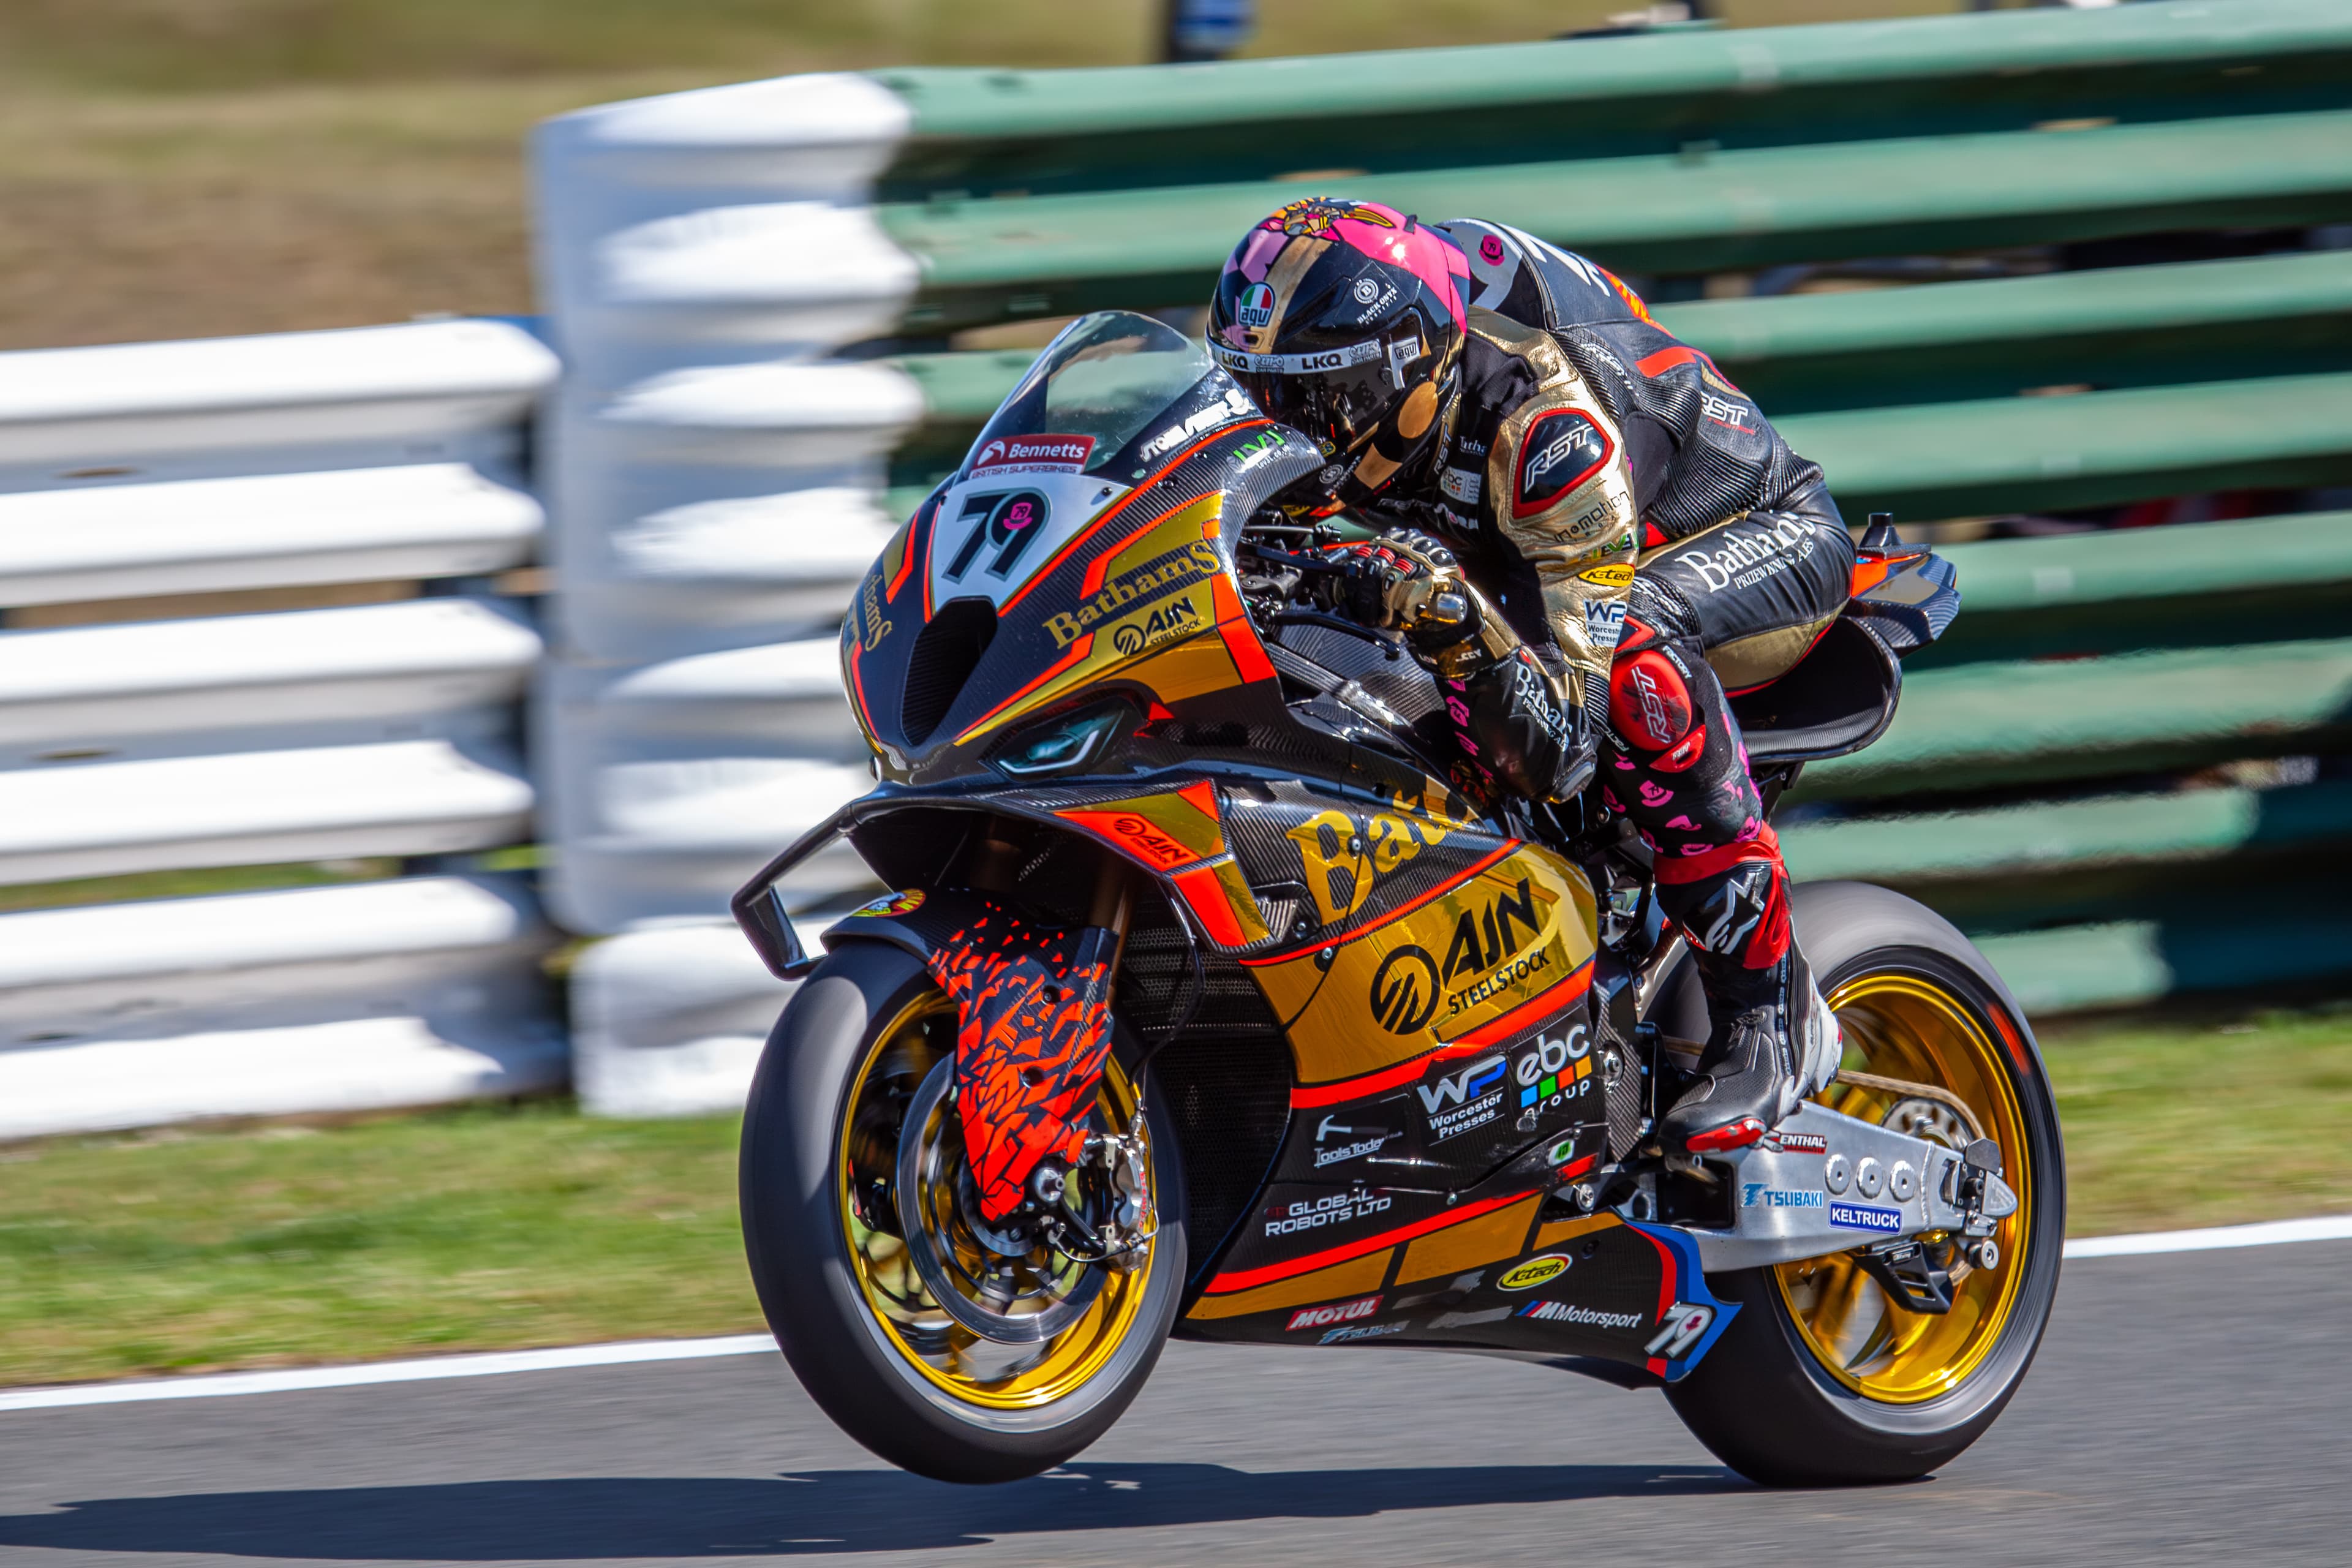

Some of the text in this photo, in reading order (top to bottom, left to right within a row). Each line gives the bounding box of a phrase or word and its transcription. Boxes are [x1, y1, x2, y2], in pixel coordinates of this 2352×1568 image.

[1240, 308, 1270, 326] agv
[1357, 303, 1381, 325] BLACK
[1380, 287, 1398, 306] ONYX
[1222, 352, 1250, 370] LKQ
[1302, 353, 1343, 369] LKQ
[1395, 343, 1417, 358] agv
[1008, 443, 1085, 460] Bennetts
[1434, 423, 1452, 475] RST
[1524, 423, 1594, 494] RST
[971, 464, 1077, 480] BRITISH SUPERBIKES
[941, 487, 1052, 585] 79
[1145, 596, 1198, 638] AJN
[1150, 620, 1201, 647] STEELSTOCK
[1630, 666, 1672, 744] RST
[1140, 834, 1191, 862] AJN
[1441, 876, 1542, 990] AJN
[1447, 946, 1551, 1016] STEELSTOCK
[1517, 1023, 1591, 1087] ebc
[1416, 1054, 1507, 1114] WP
[1429, 1092, 1504, 1130] Worcester
[1438, 1109, 1496, 1139] Presses
[1288, 1188, 1374, 1217] GLOBAL
[1764, 1190, 1823, 1207] TSUBAKI
[1265, 1196, 1392, 1237] ROBOTS LTD
[1831, 1208, 1899, 1229] KELTRUCK
[1289, 1299, 1377, 1329] MOTUL
[1554, 1305, 1642, 1329] Motorsport
[1644, 1303, 1713, 1359] 79
